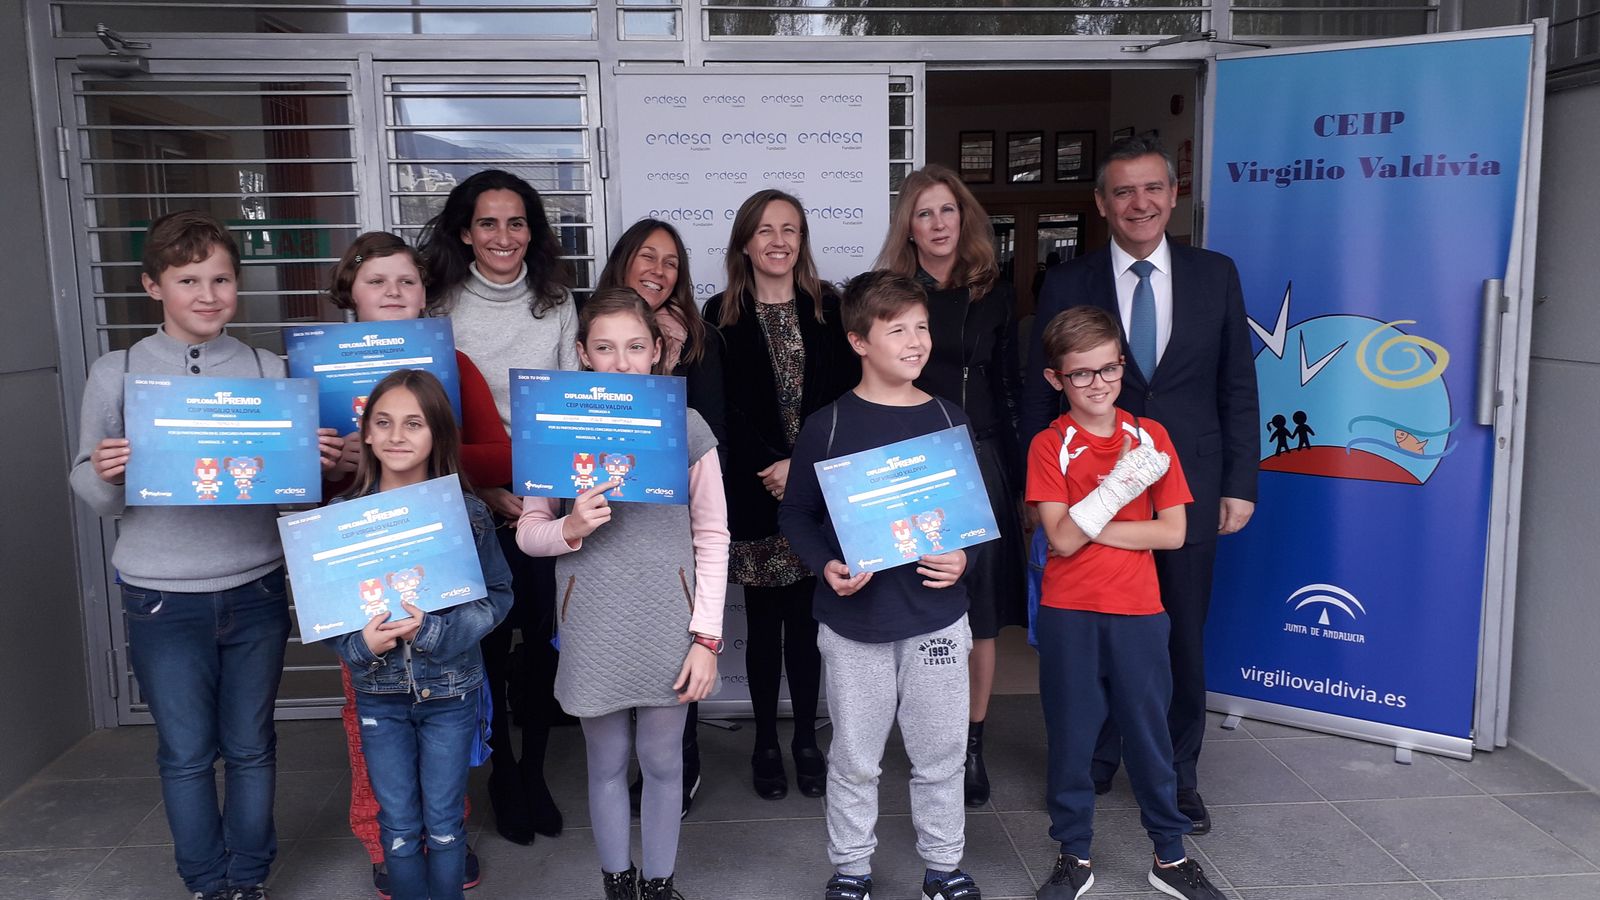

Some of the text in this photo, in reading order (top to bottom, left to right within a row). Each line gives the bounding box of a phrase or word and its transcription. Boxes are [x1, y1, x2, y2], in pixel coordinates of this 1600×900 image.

[643, 95, 687, 104] endesa
[702, 94, 746, 104] endesa
[761, 94, 804, 103] endesa
[820, 93, 863, 103] endesa
[1313, 111, 1406, 138] CEIP
[646, 132, 712, 145] endesa
[722, 131, 787, 145] endesa
[797, 129, 863, 144] endesa
[647, 171, 690, 181] endesa
[705, 170, 748, 180] endesa
[762, 170, 806, 180] endesa
[820, 170, 864, 180] endesa
[1226, 153, 1501, 189] Virgilio Valdivia
[649, 208, 714, 220] endesa
[822, 245, 864, 254] endesa
[370, 337, 405, 346] PREMIO
[222, 397, 262, 405] PREMIO
[598, 392, 633, 402] PREMIO
[274, 487, 306, 495] endesa
[645, 486, 674, 495] endesa
[440, 586, 471, 599] endesa
[1283, 622, 1365, 644] JUNTA DE ANDALUCIA
[918, 638, 958, 652] WLMSBRG
[928, 646, 949, 657] 1993
[923, 656, 957, 665] LEAGUE
[1240, 665, 1407, 708] virgiliovaldivia.es
